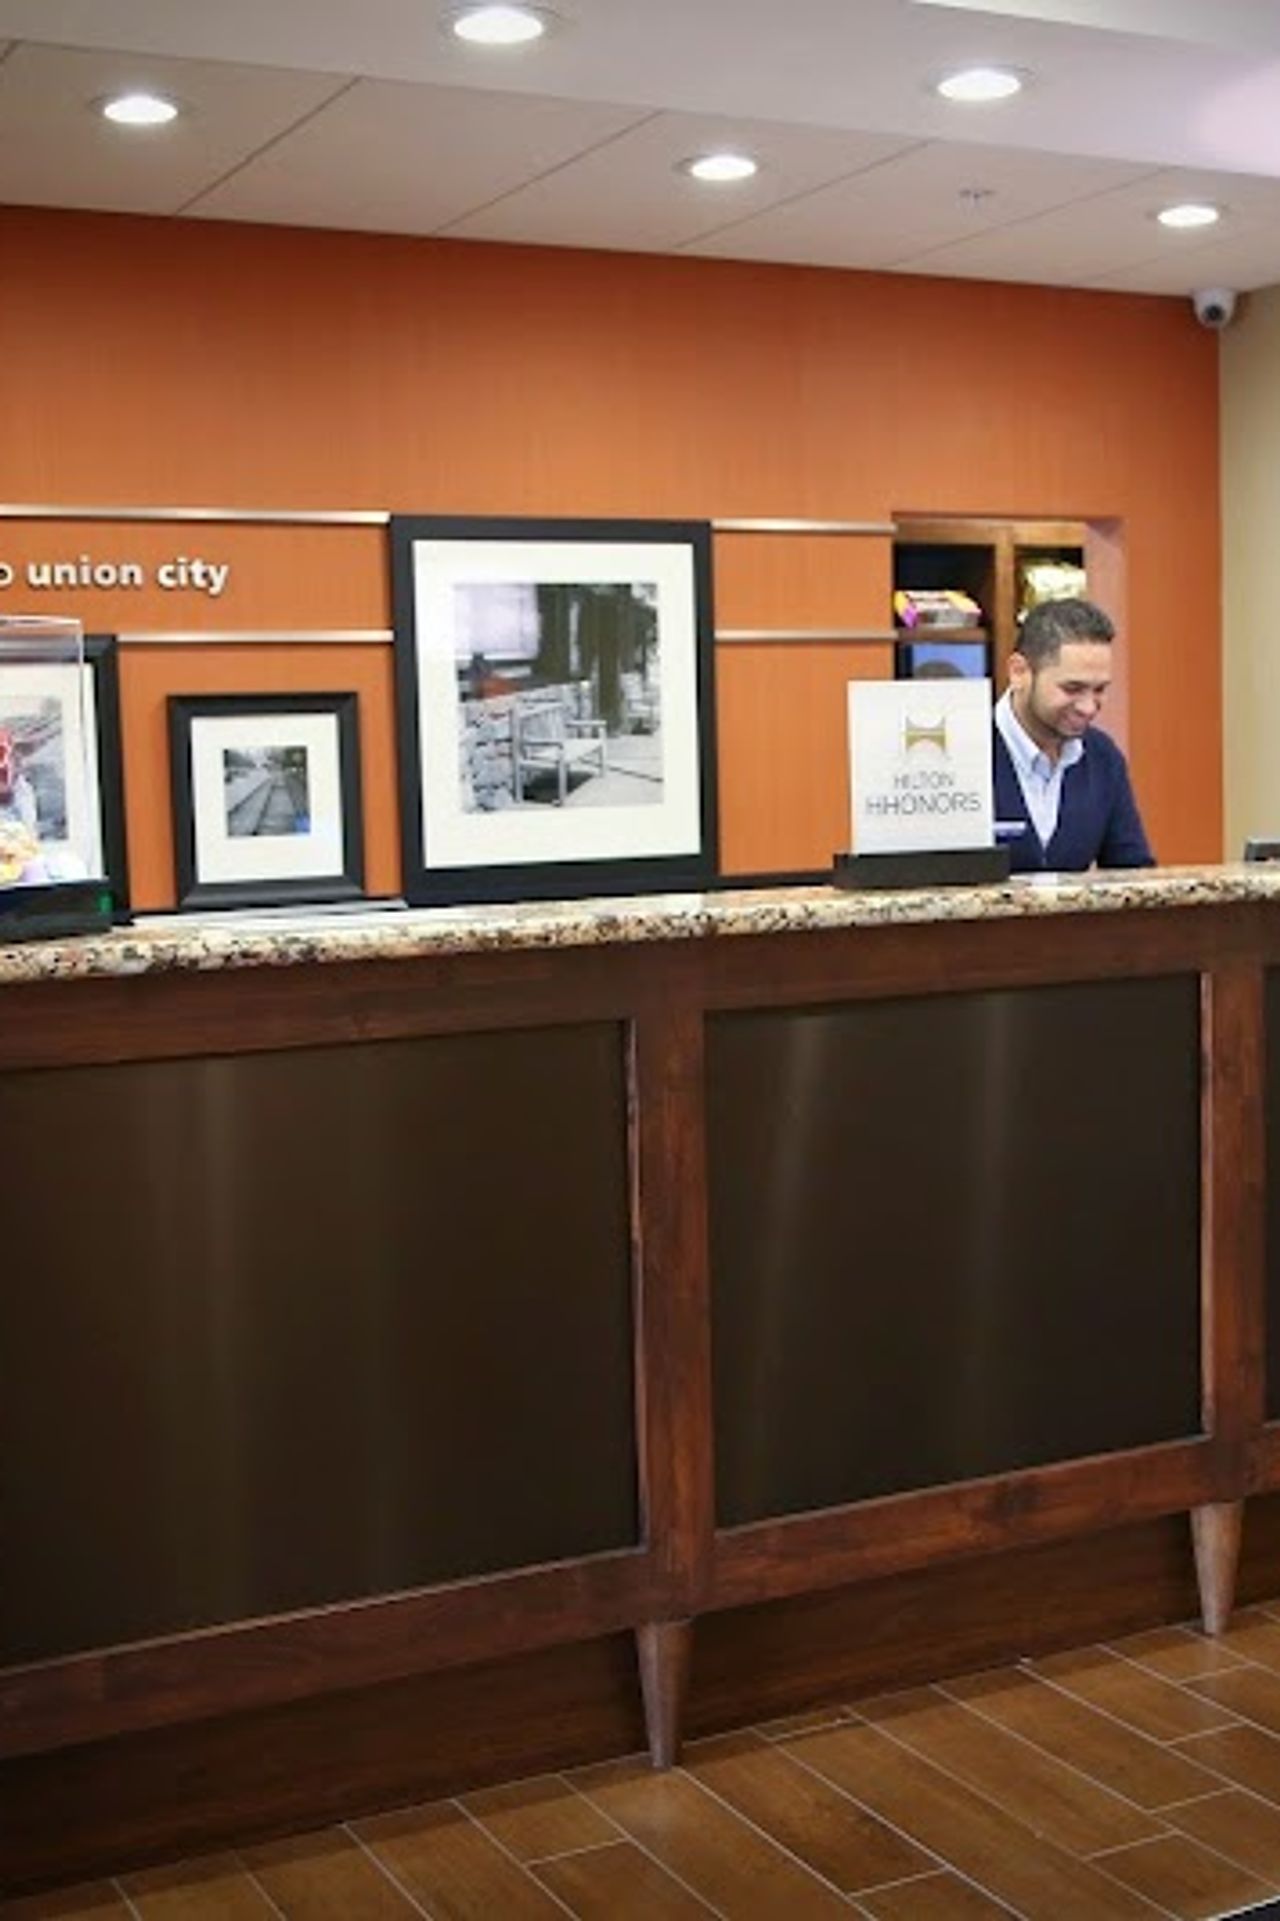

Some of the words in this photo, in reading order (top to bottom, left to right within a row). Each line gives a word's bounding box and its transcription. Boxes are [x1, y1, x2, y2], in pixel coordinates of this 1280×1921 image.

[28, 555, 143, 587] union
[158, 556, 229, 596] city
[893, 771, 954, 790] HILTON
[865, 793, 982, 816] HHONORS
